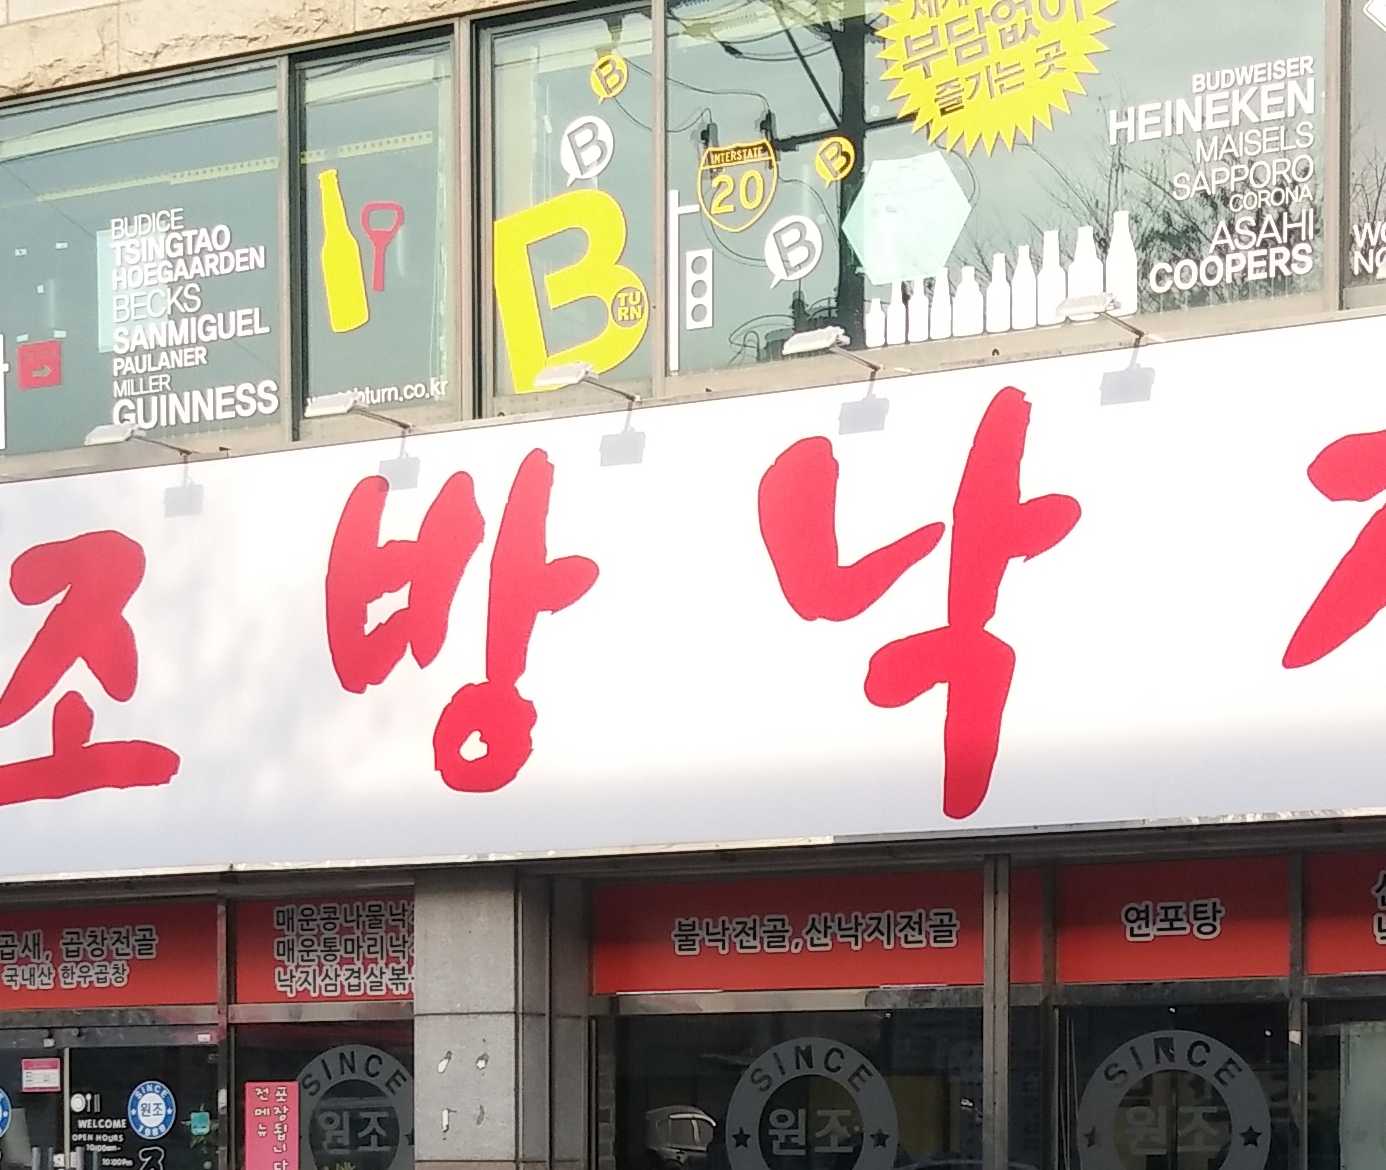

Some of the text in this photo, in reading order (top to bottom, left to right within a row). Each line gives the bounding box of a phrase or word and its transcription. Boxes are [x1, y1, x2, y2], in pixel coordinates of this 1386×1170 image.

[934, 40, 1066, 117] 즐기는 곳
[1192, 56, 1314, 94] BUDWEISER
[1109, 78, 1315, 145] HEINEKEN
[710, 145, 764, 165] INTERSTATE
[1195, 121, 1314, 164] MAISELS
[710, 170, 765, 215] 20
[1172, 154, 1314, 201] SAPPORO
[1228, 185, 1313, 213] CORONA
[110, 209, 184, 241] BUDICE
[111, 224, 231, 267] TSINGTAO
[1208, 209, 1314, 254] ASAHI
[112, 246, 265, 291] HOEGAARDEN
[1149, 244, 1314, 293] COOPERS
[112, 283, 201, 323] BECKS
[112, 308, 270, 355] SANMIGUEL
[113, 347, 208, 377] PAULANER
[113, 374, 171, 398] MILLER
[113, 379, 279, 430] GUINNESS
[274, 901, 415, 934] 매운콩나물낙
[1121, 898, 1226, 942] 연포탕
[60, 925, 158, 962] 곱창전골
[274, 931, 415, 965] 매운통마리낙
[2, 960, 129, 991] 국내산 한우곱창
[274, 962, 415, 998] 낙지삼겹살볶
[302, 1051, 407, 1097] SINCE
[750, 1043, 874, 1093] SINCE
[1103, 1036, 1243, 1089] SINCE
[77, 1119, 128, 1129] WELCOME
[140, 1102, 164, 1118] 원조
[768, 1107, 856, 1156] 원조
[1124, 1105, 1220, 1158] 원조
[72, 1133, 124, 1142] OPEN HOURS
[318, 1110, 391, 1155] 원조
